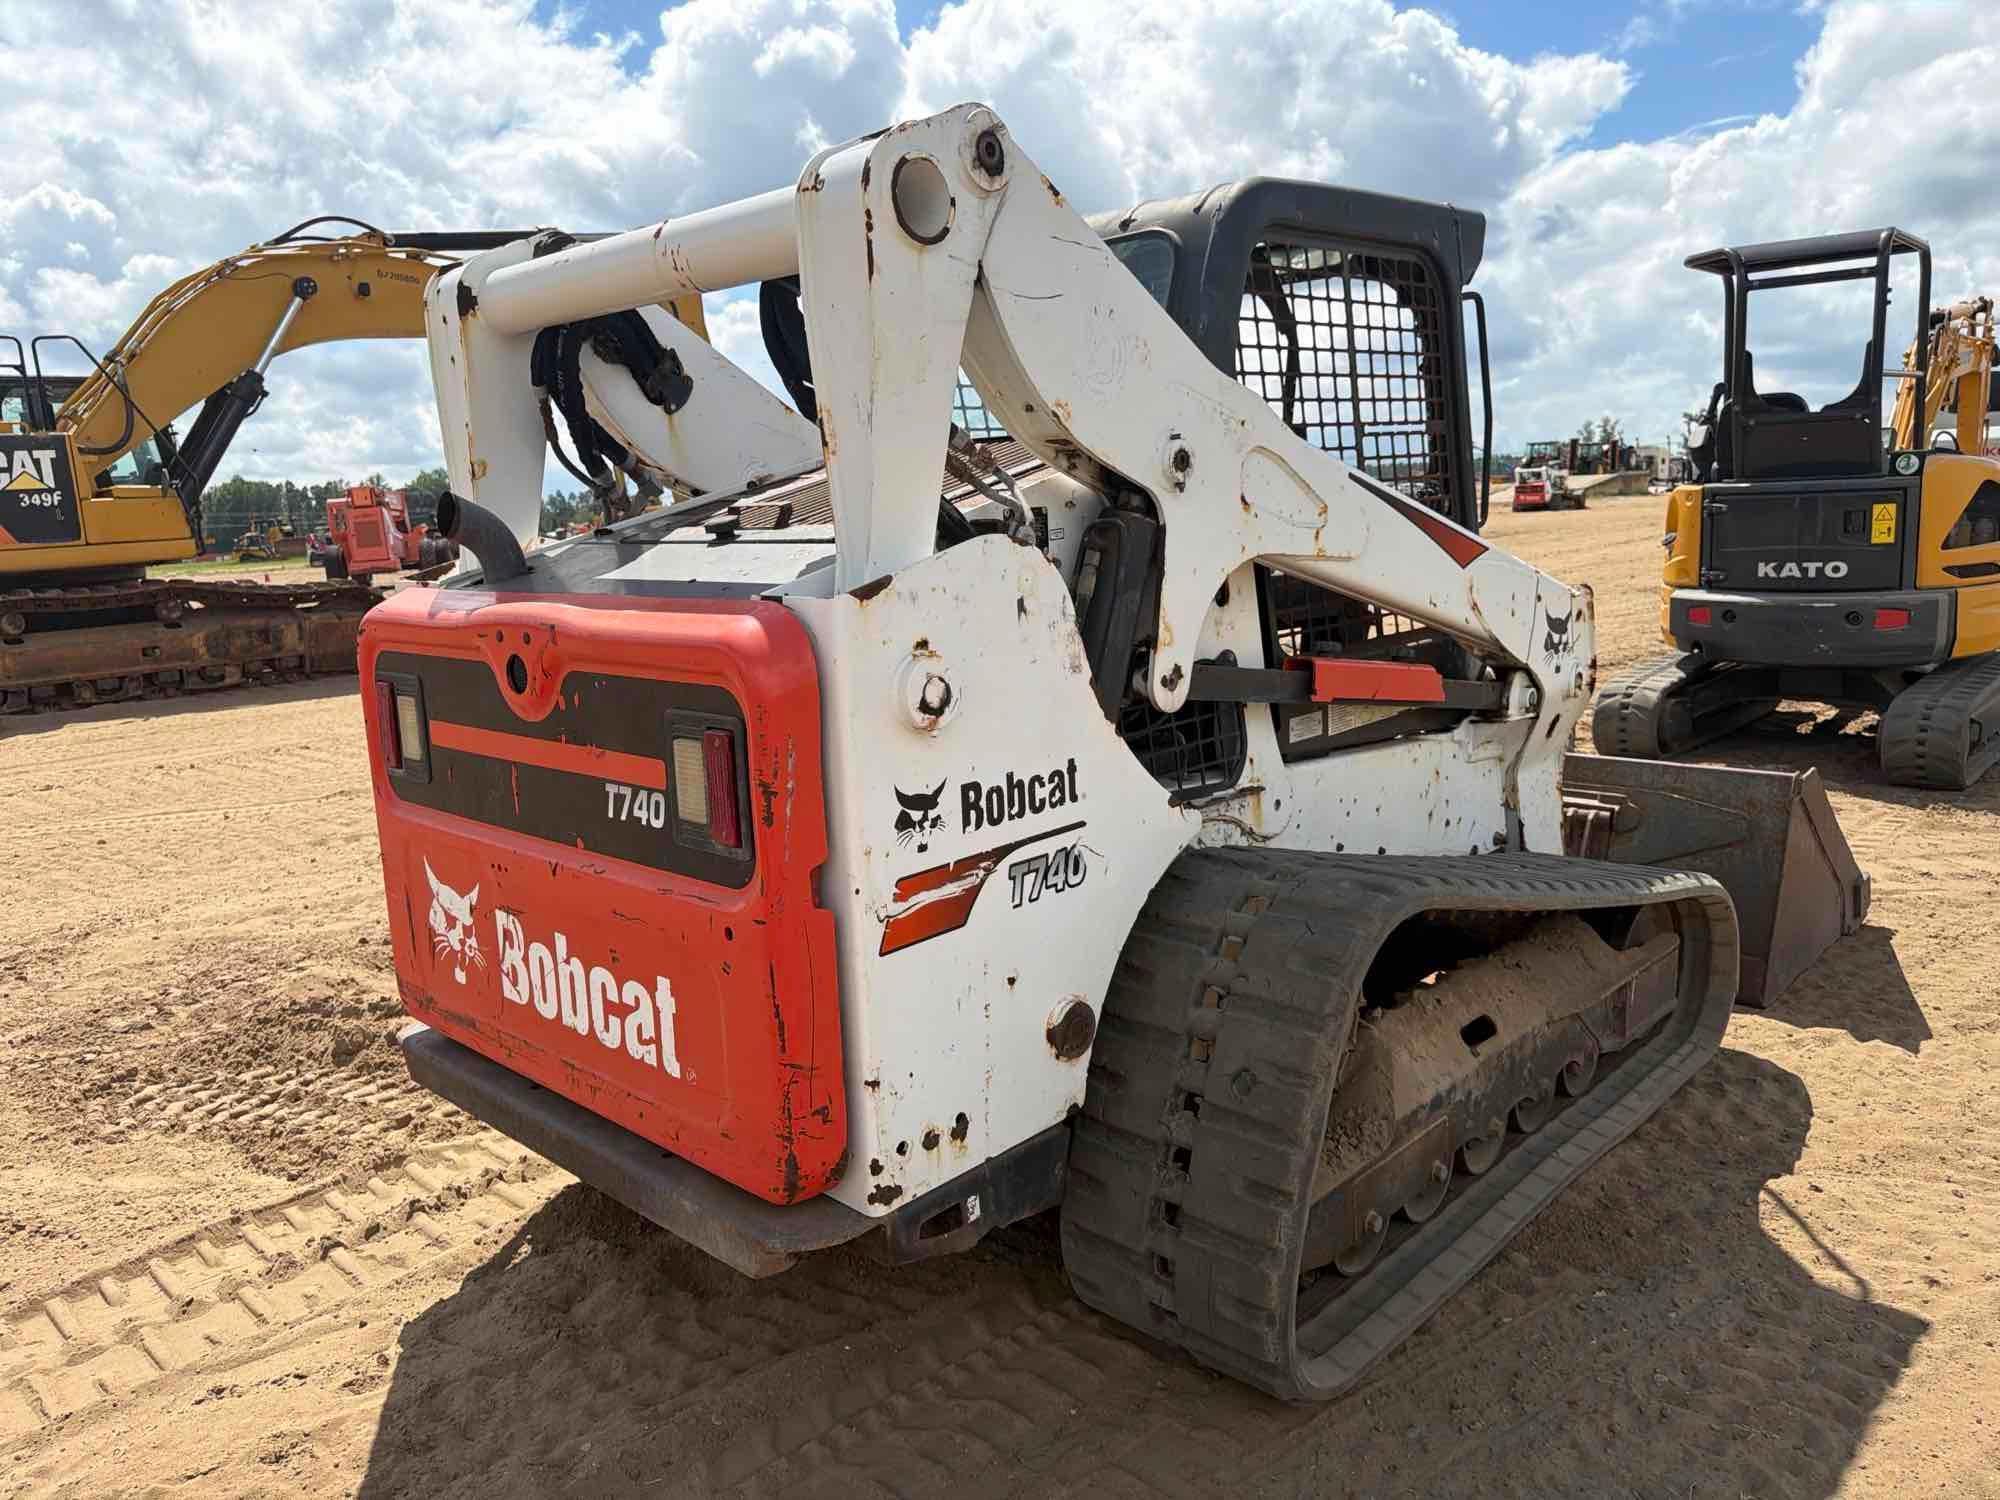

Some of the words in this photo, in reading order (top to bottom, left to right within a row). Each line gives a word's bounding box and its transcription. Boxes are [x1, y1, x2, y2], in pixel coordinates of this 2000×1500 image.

[19, 491, 62, 506] 349F
[1757, 560, 1849, 578] KATO
[604, 782, 666, 829] T740
[960, 757, 1079, 835] Bobcat
[1008, 845, 1087, 910] T740
[495, 908, 680, 1079] Bobcat
